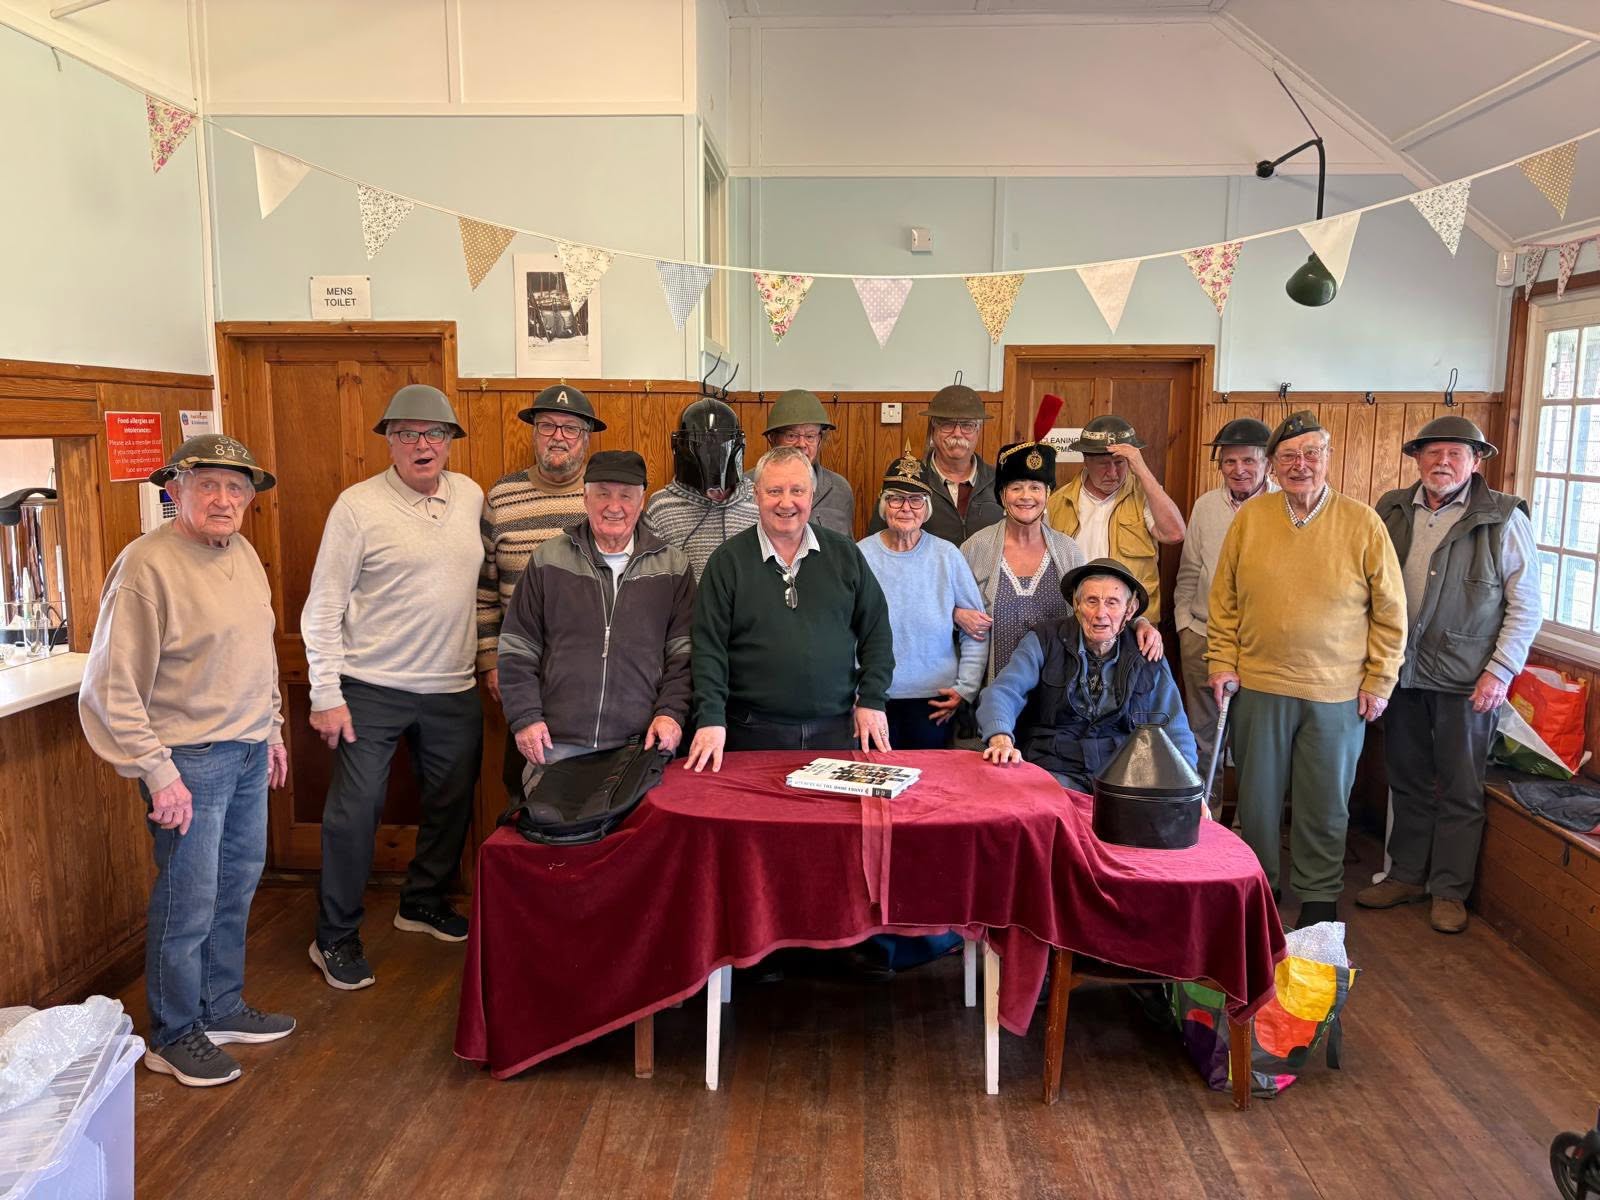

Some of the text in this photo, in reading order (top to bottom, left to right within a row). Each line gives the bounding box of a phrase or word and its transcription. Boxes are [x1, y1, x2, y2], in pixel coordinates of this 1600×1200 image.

[326, 287, 353, 295] MENS
[324, 298, 356, 307] TOILET
[556, 390, 569, 404] A
